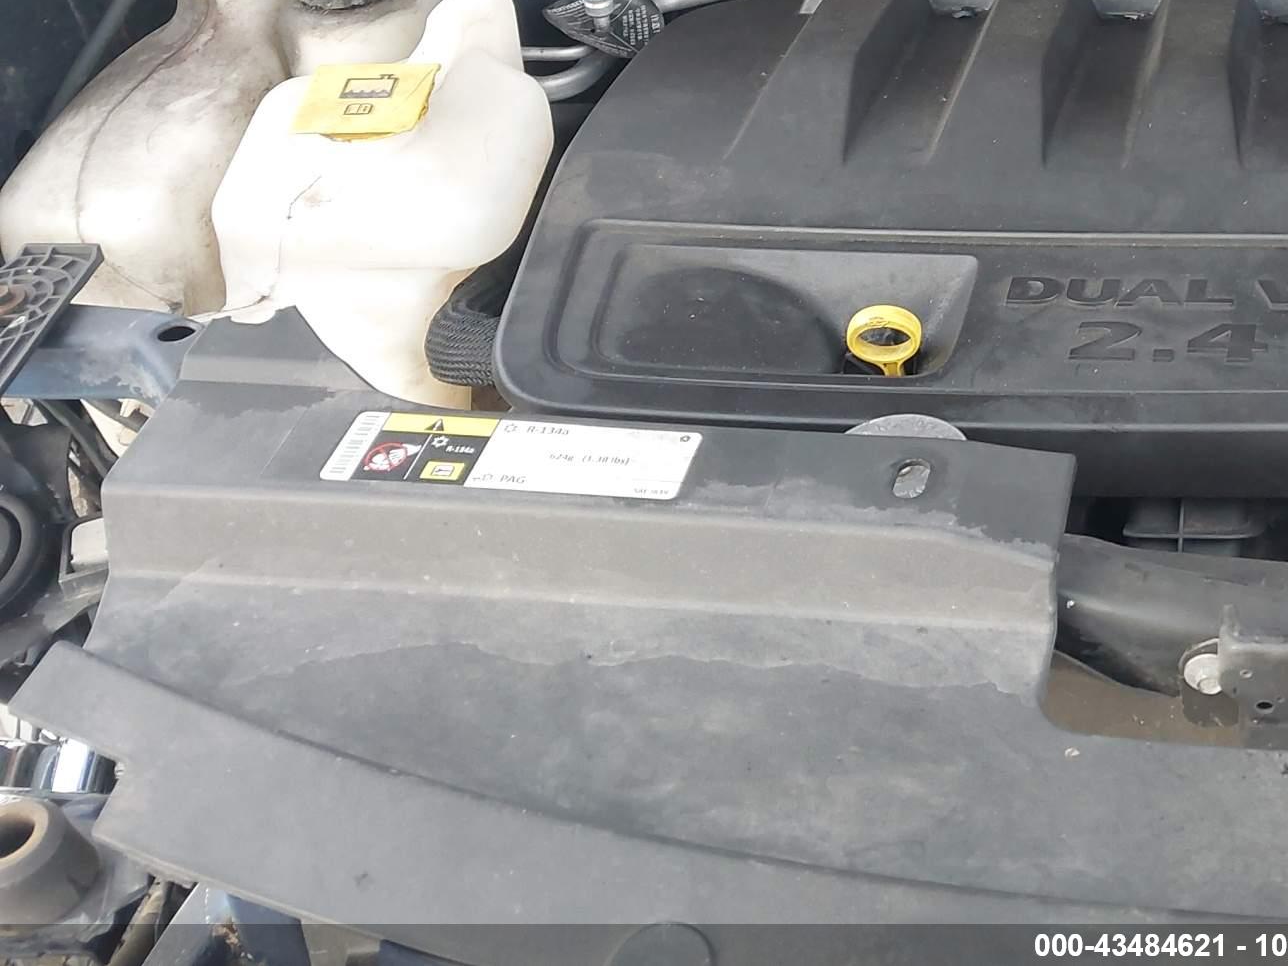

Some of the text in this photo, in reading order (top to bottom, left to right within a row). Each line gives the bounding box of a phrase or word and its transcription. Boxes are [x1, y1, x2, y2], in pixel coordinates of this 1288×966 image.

[1003, 276, 1235, 308] DUAL
[526, 425, 570, 436] R-134a
[500, 474, 527, 484] PAG
